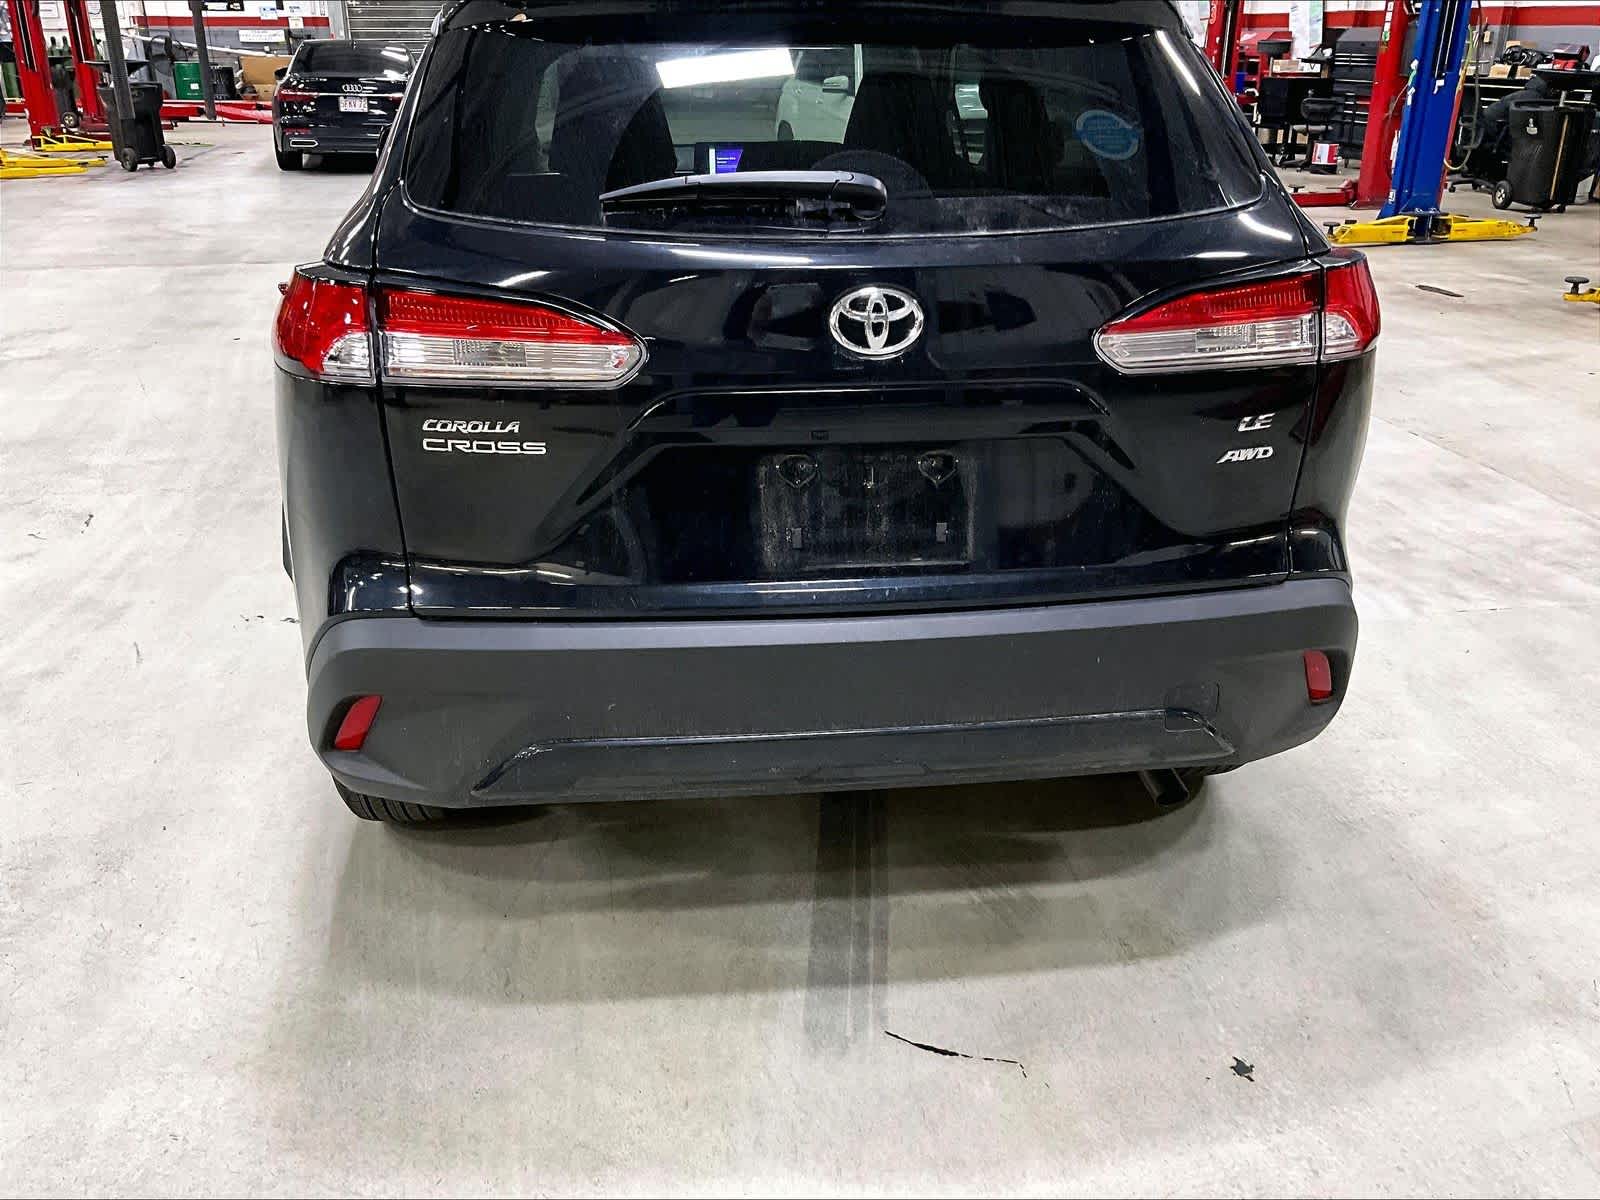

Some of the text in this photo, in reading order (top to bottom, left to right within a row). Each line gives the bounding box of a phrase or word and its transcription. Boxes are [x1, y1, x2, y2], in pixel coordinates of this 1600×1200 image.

[422, 418, 521, 433] COROLLA
[1238, 412, 1276, 432] LE
[422, 438, 547, 455] CROSS
[1216, 446, 1274, 464] AWD
